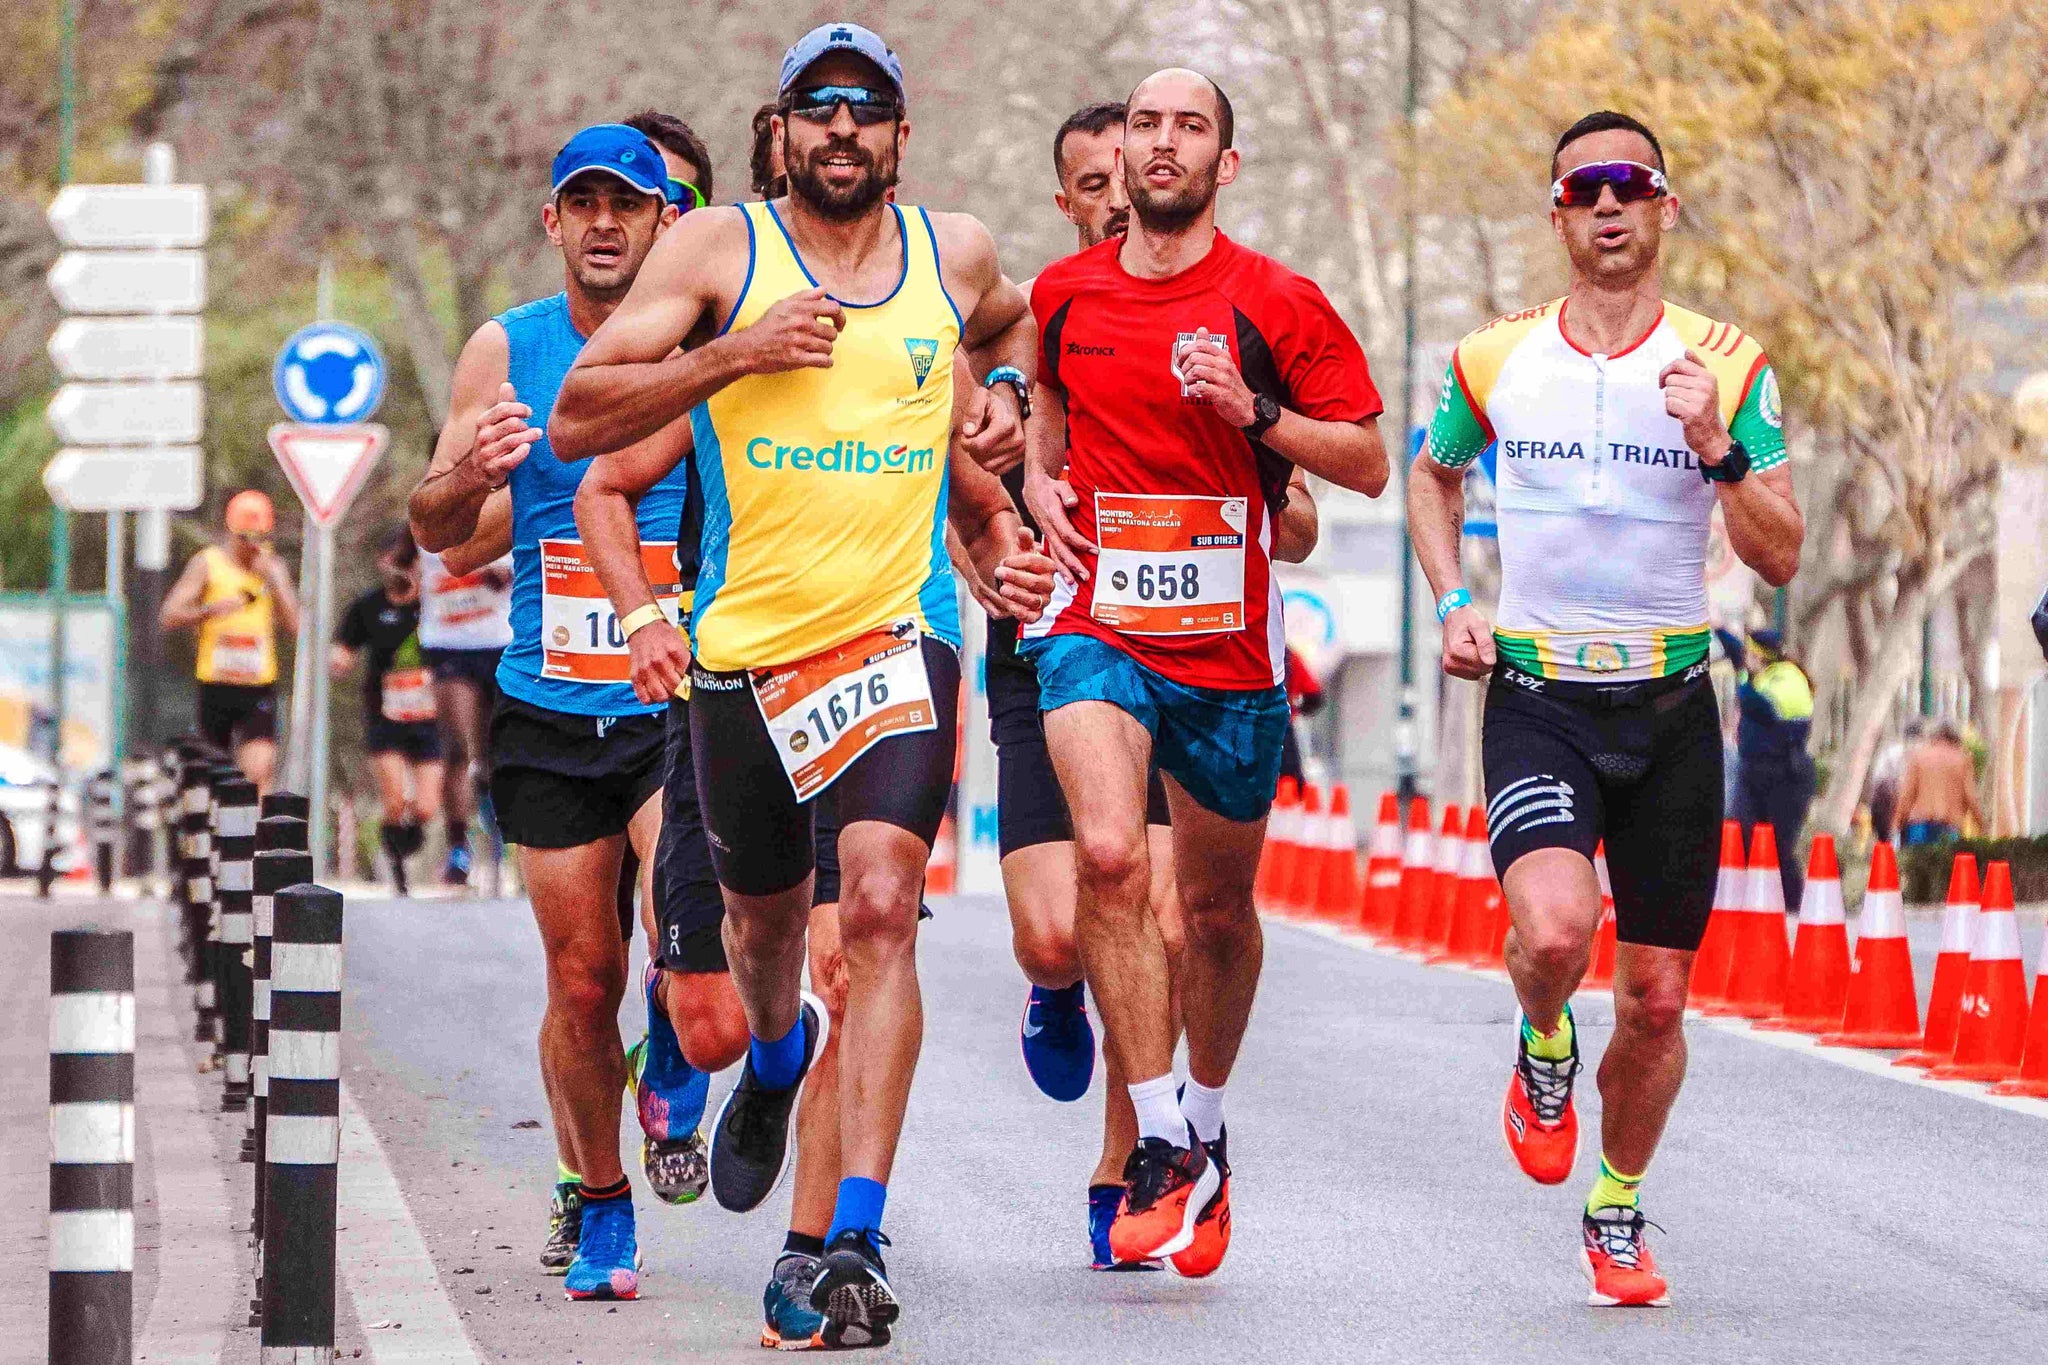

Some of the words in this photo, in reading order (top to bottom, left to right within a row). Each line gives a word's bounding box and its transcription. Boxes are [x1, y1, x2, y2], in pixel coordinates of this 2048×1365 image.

[746, 437, 934, 474] Credibom
[1505, 440, 1585, 460] SFRAA
[1608, 442, 1701, 470] TRIATL
[1197, 536, 1212, 545] SUB
[1214, 535, 1238, 545] 01H25
[1137, 563, 1200, 601] 658
[869, 651, 887, 664] SUB
[694, 678, 743, 690] TRIATHLON
[807, 673, 889, 744] 1676
